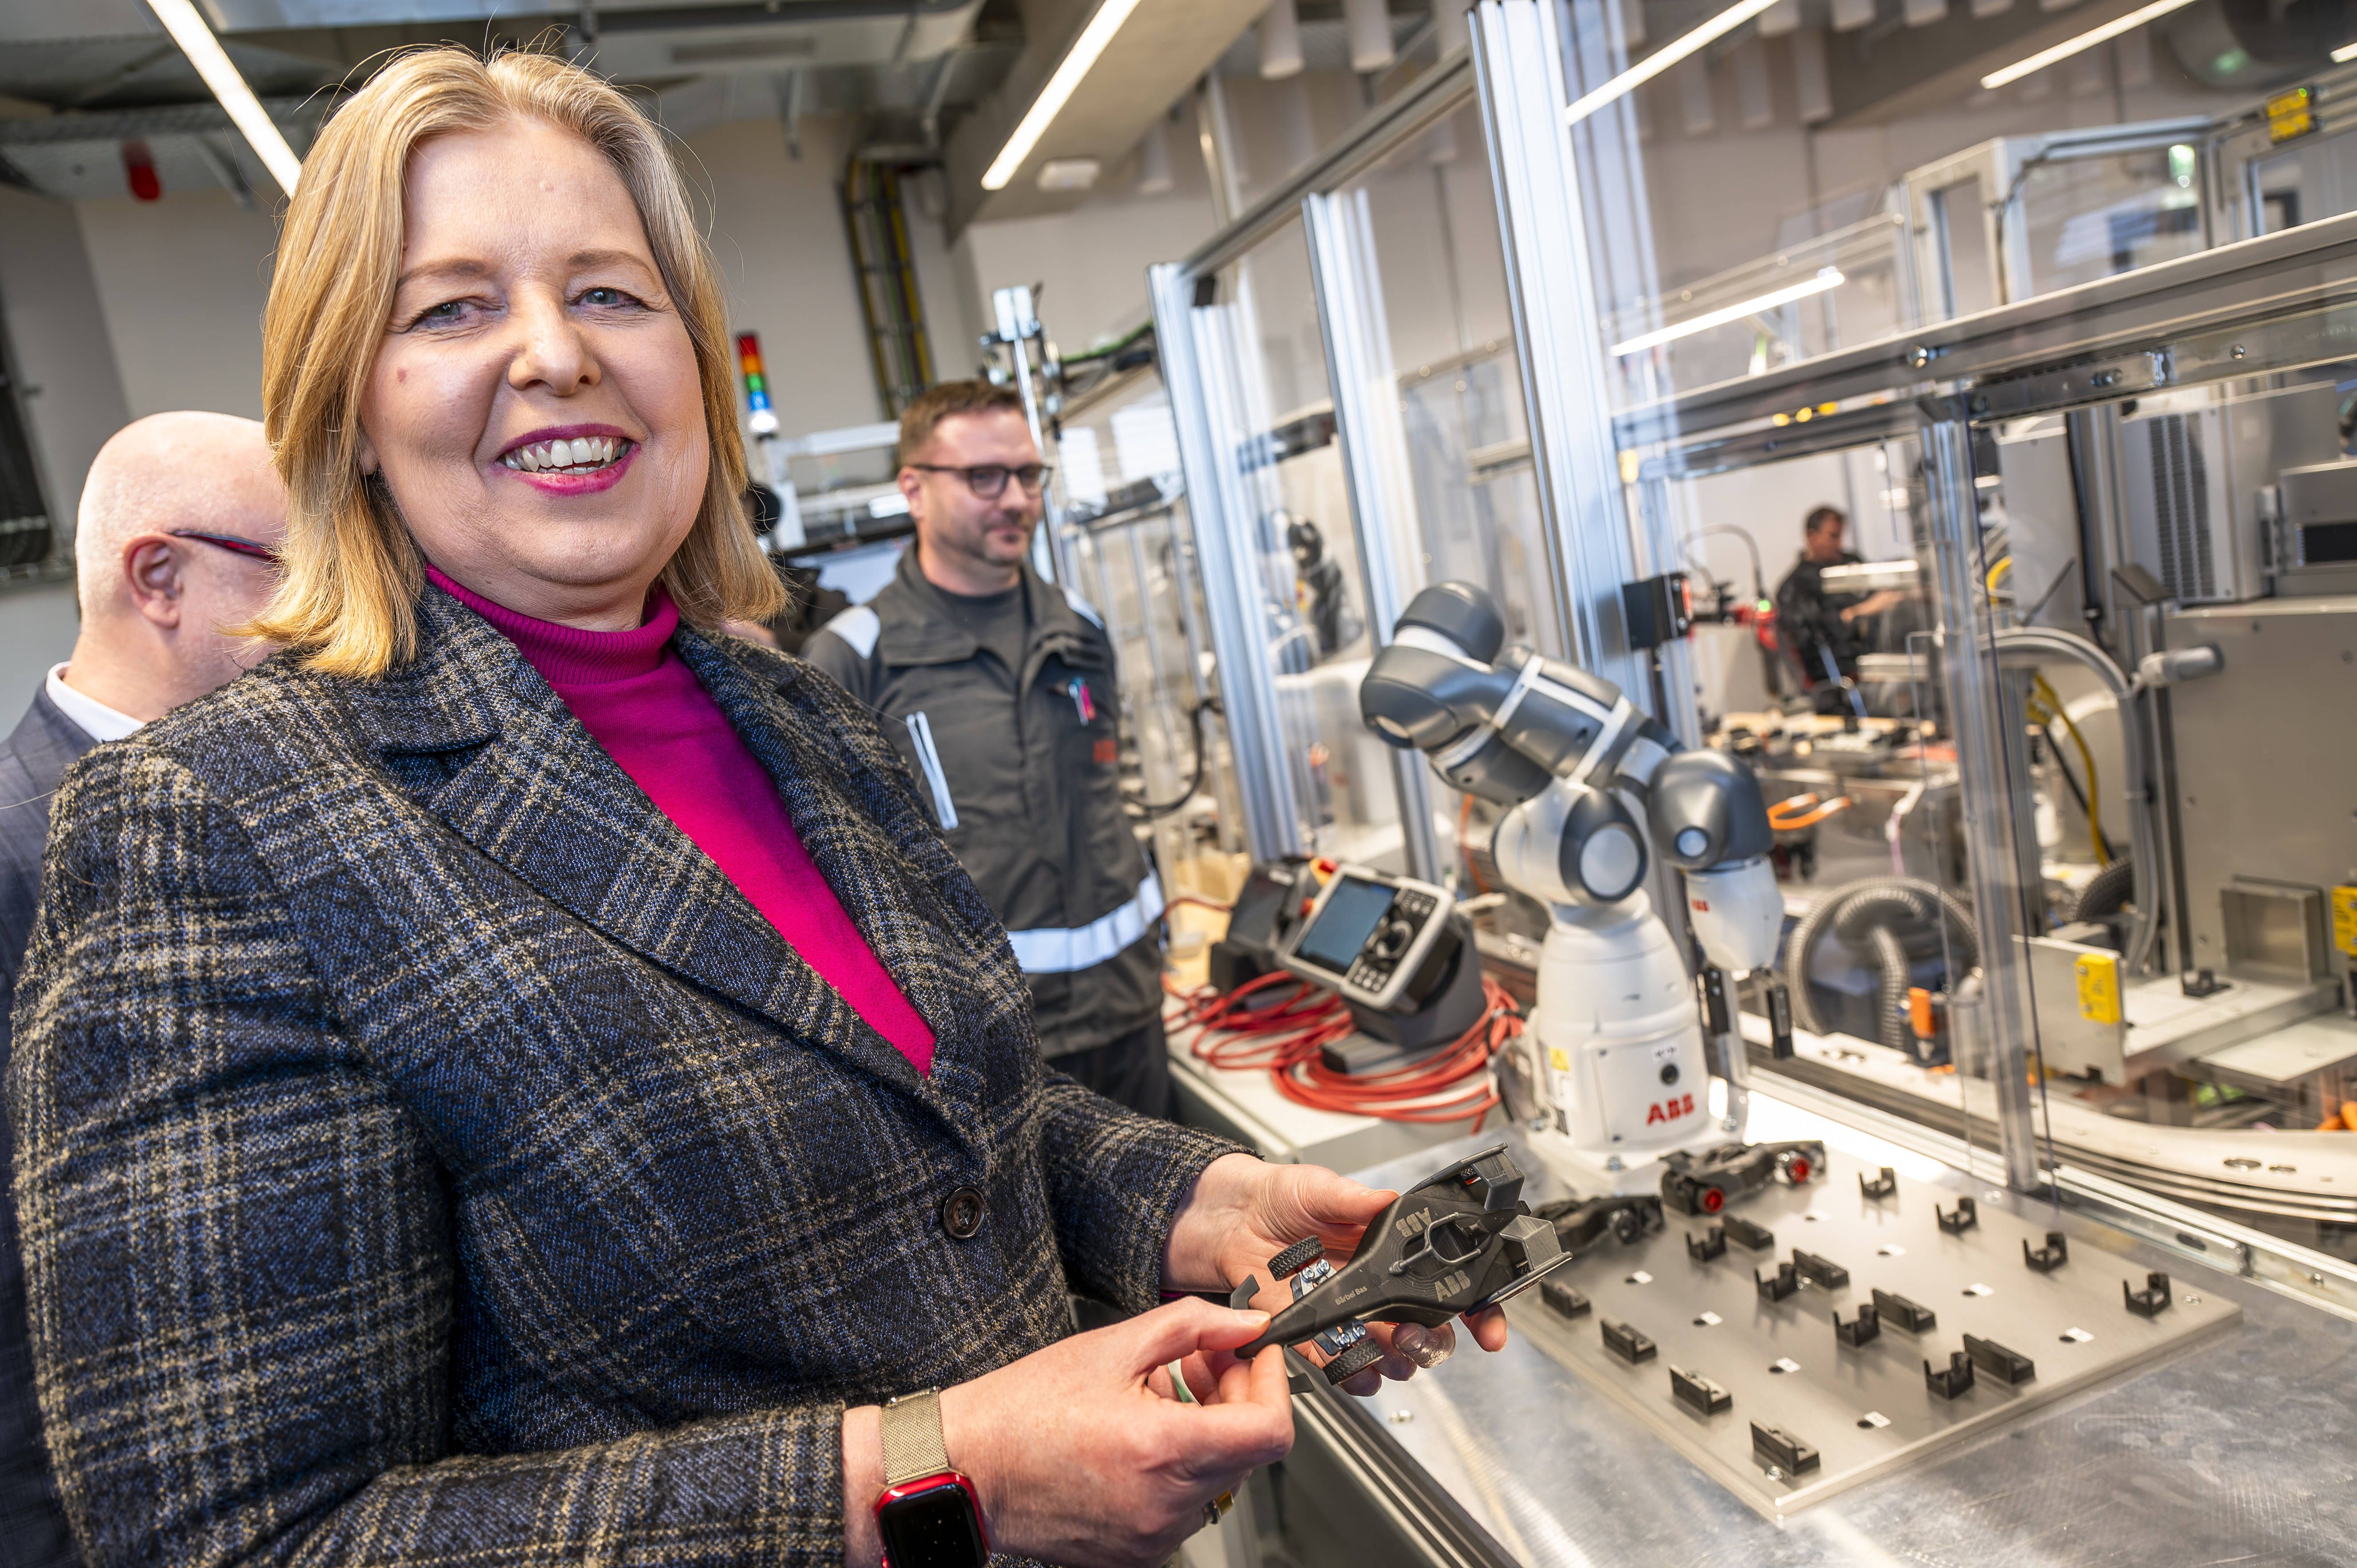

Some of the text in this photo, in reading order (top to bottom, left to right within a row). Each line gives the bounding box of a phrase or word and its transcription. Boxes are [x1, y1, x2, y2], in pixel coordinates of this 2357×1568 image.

[1647, 1093, 1694, 1126] ABB
[1396, 1207, 1431, 1237] ABB
[1355, 1286, 1367, 1295] Bas
[1434, 1270, 1471, 1303] ABB
